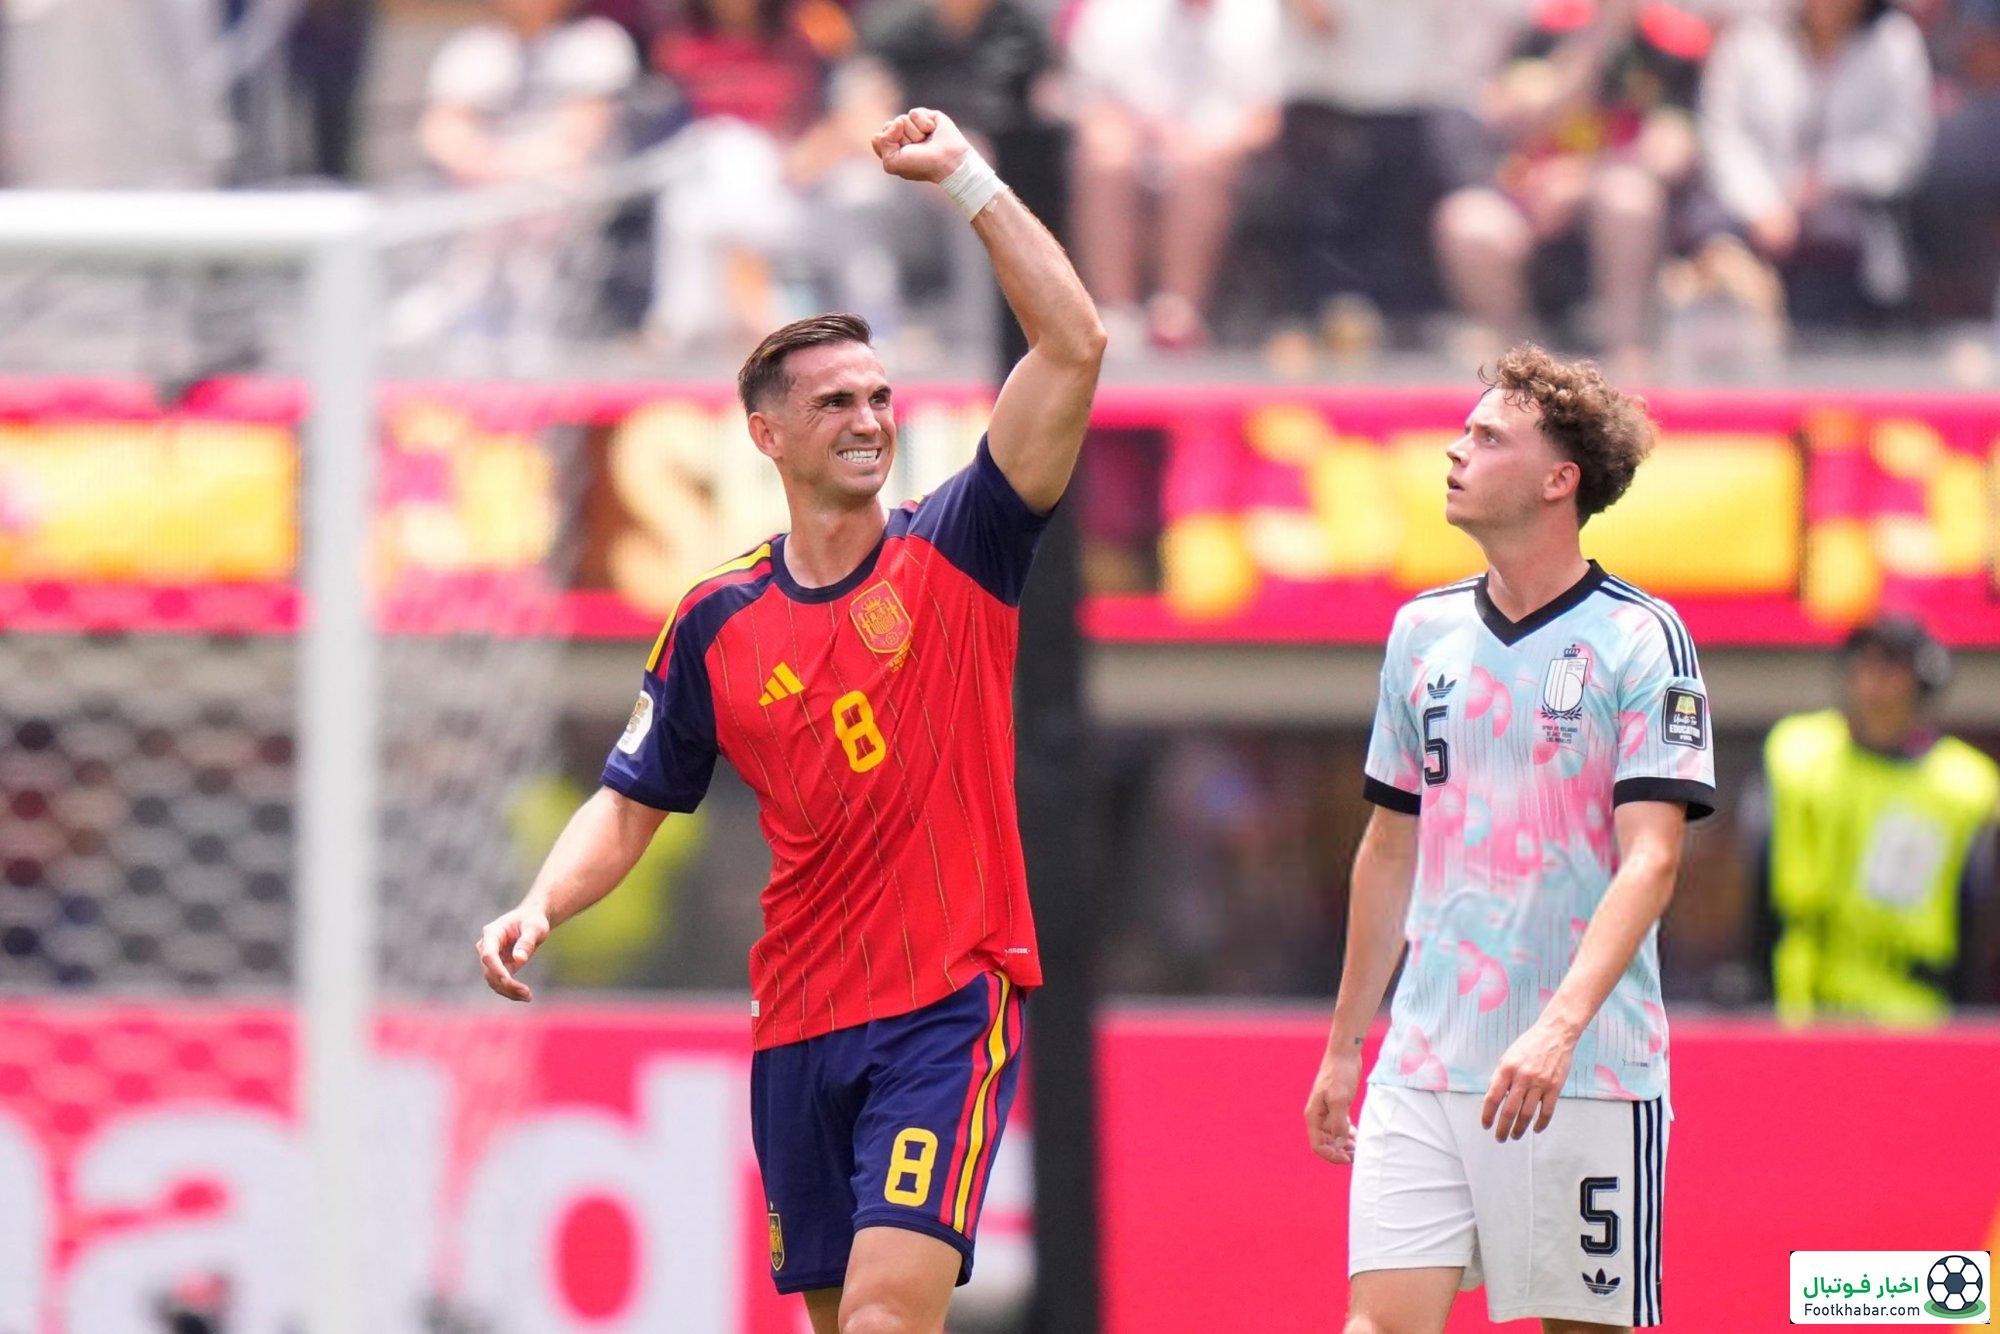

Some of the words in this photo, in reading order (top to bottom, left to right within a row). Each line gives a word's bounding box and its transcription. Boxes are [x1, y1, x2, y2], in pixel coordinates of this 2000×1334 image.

[832, 690, 887, 773] 8
[1423, 705, 1450, 788] 5
[884, 1127, 938, 1207] 8
[1580, 1177, 1620, 1257] 5
